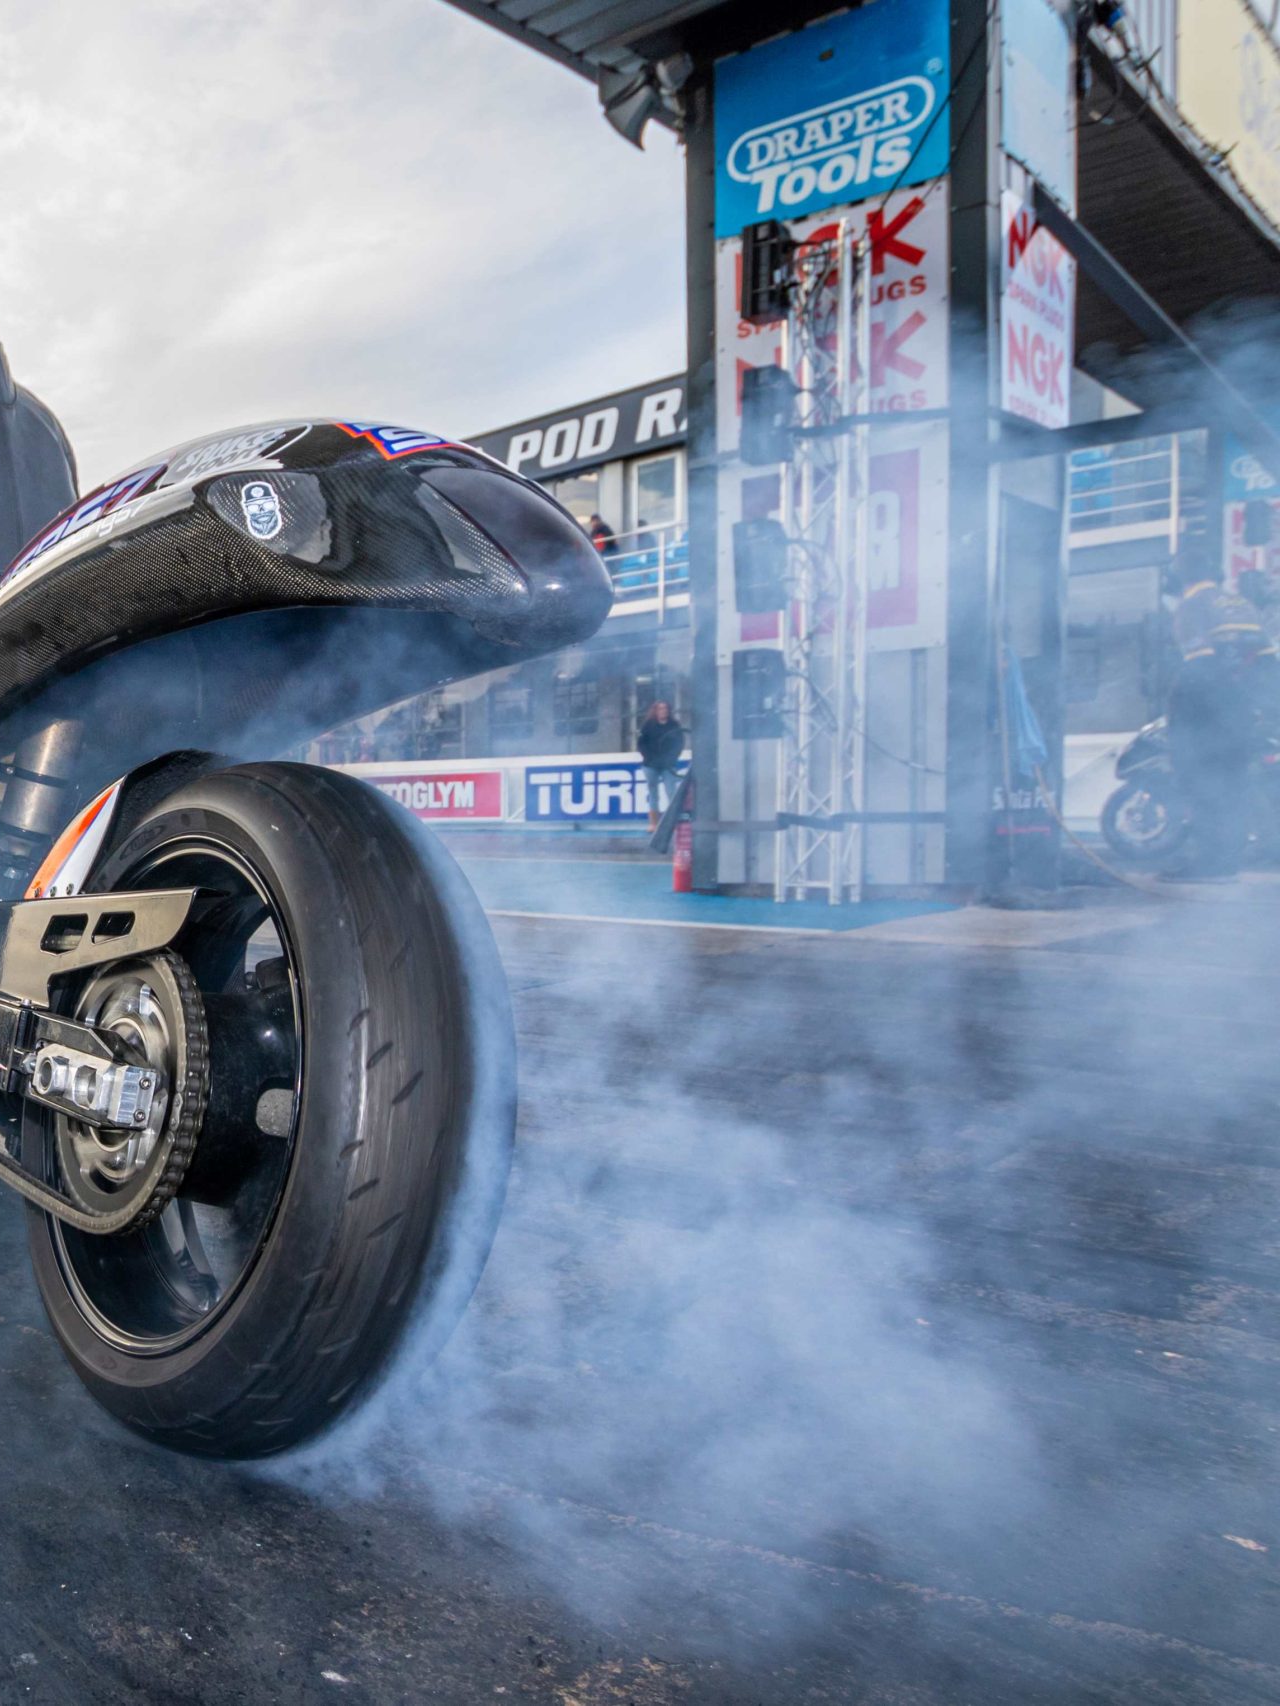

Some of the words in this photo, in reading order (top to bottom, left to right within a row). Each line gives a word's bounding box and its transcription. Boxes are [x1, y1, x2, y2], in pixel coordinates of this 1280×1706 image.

[746, 90, 913, 171] DRAPER
[750, 133, 912, 214] Tools
[1008, 321, 1064, 409] NGK
[506, 406, 619, 473] POD
[635, 387, 688, 444] R
